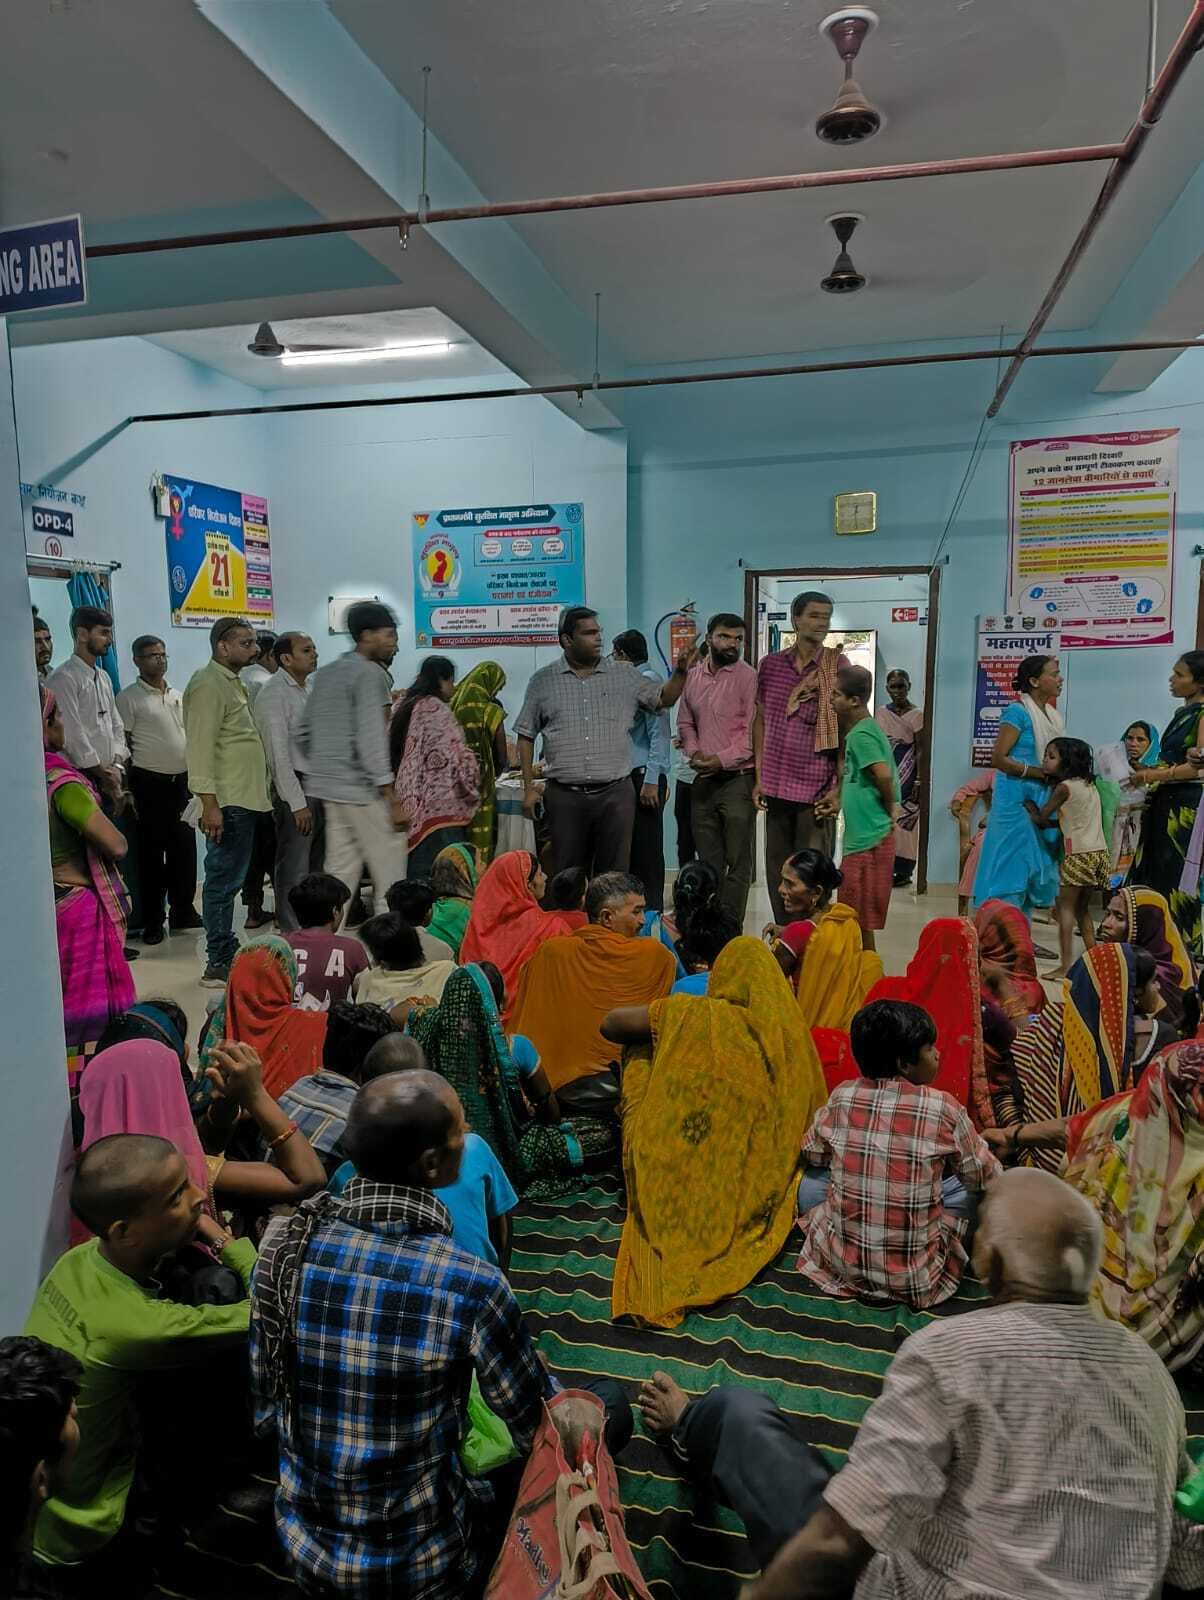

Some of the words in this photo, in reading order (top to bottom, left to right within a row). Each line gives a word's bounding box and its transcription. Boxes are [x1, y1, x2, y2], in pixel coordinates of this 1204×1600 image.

[29, 240, 80, 292] AREA
[1033, 478, 1044, 486] 12
[1123, 470, 1132, 479] से
[1063, 464, 1073, 472] का
[34, 512, 72, 532] OPD-4
[188, 504, 206, 520] परिवार
[207, 507, 227, 524] नियोजन
[50, 543, 59, 557] 10
[211, 552, 229, 587] 21
[985, 633, 1053, 653] महत्वपूर्ण
[43, 1279, 78, 1329] PUMA
